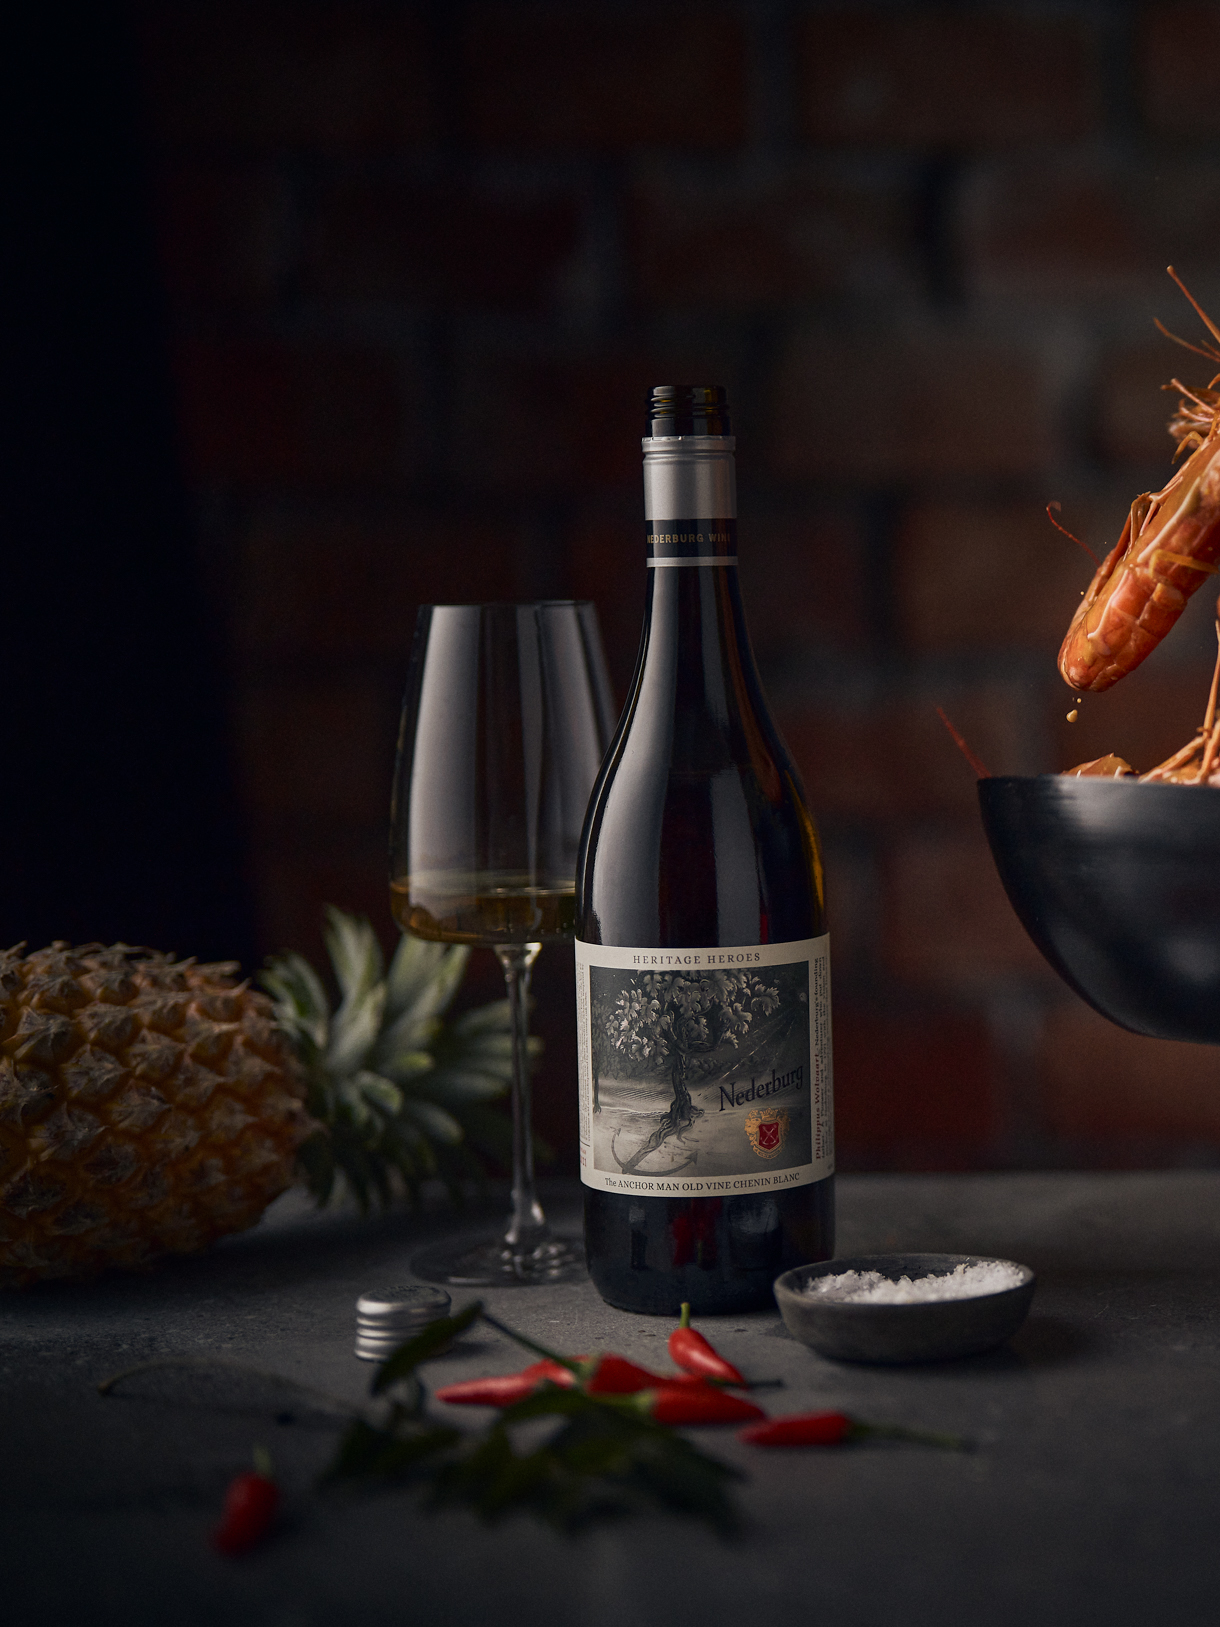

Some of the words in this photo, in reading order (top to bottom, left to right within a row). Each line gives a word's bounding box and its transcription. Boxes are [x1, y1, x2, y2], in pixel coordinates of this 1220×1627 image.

[646, 534, 704, 544] NEDERBURG
[633, 955, 701, 964] HERITAGE
[707, 952, 761, 964] HEROES
[719, 1065, 803, 1112] Nederburg
[604, 1177, 617, 1188] The
[618, 1179, 655, 1191] ANCHOR
[656, 1182, 680, 1192] MAN
[682, 1182, 704, 1191] OLD
[706, 1180, 732, 1191] VINE
[733, 1177, 771, 1189] CHENIN
[773, 1172, 800, 1184] BLANC
